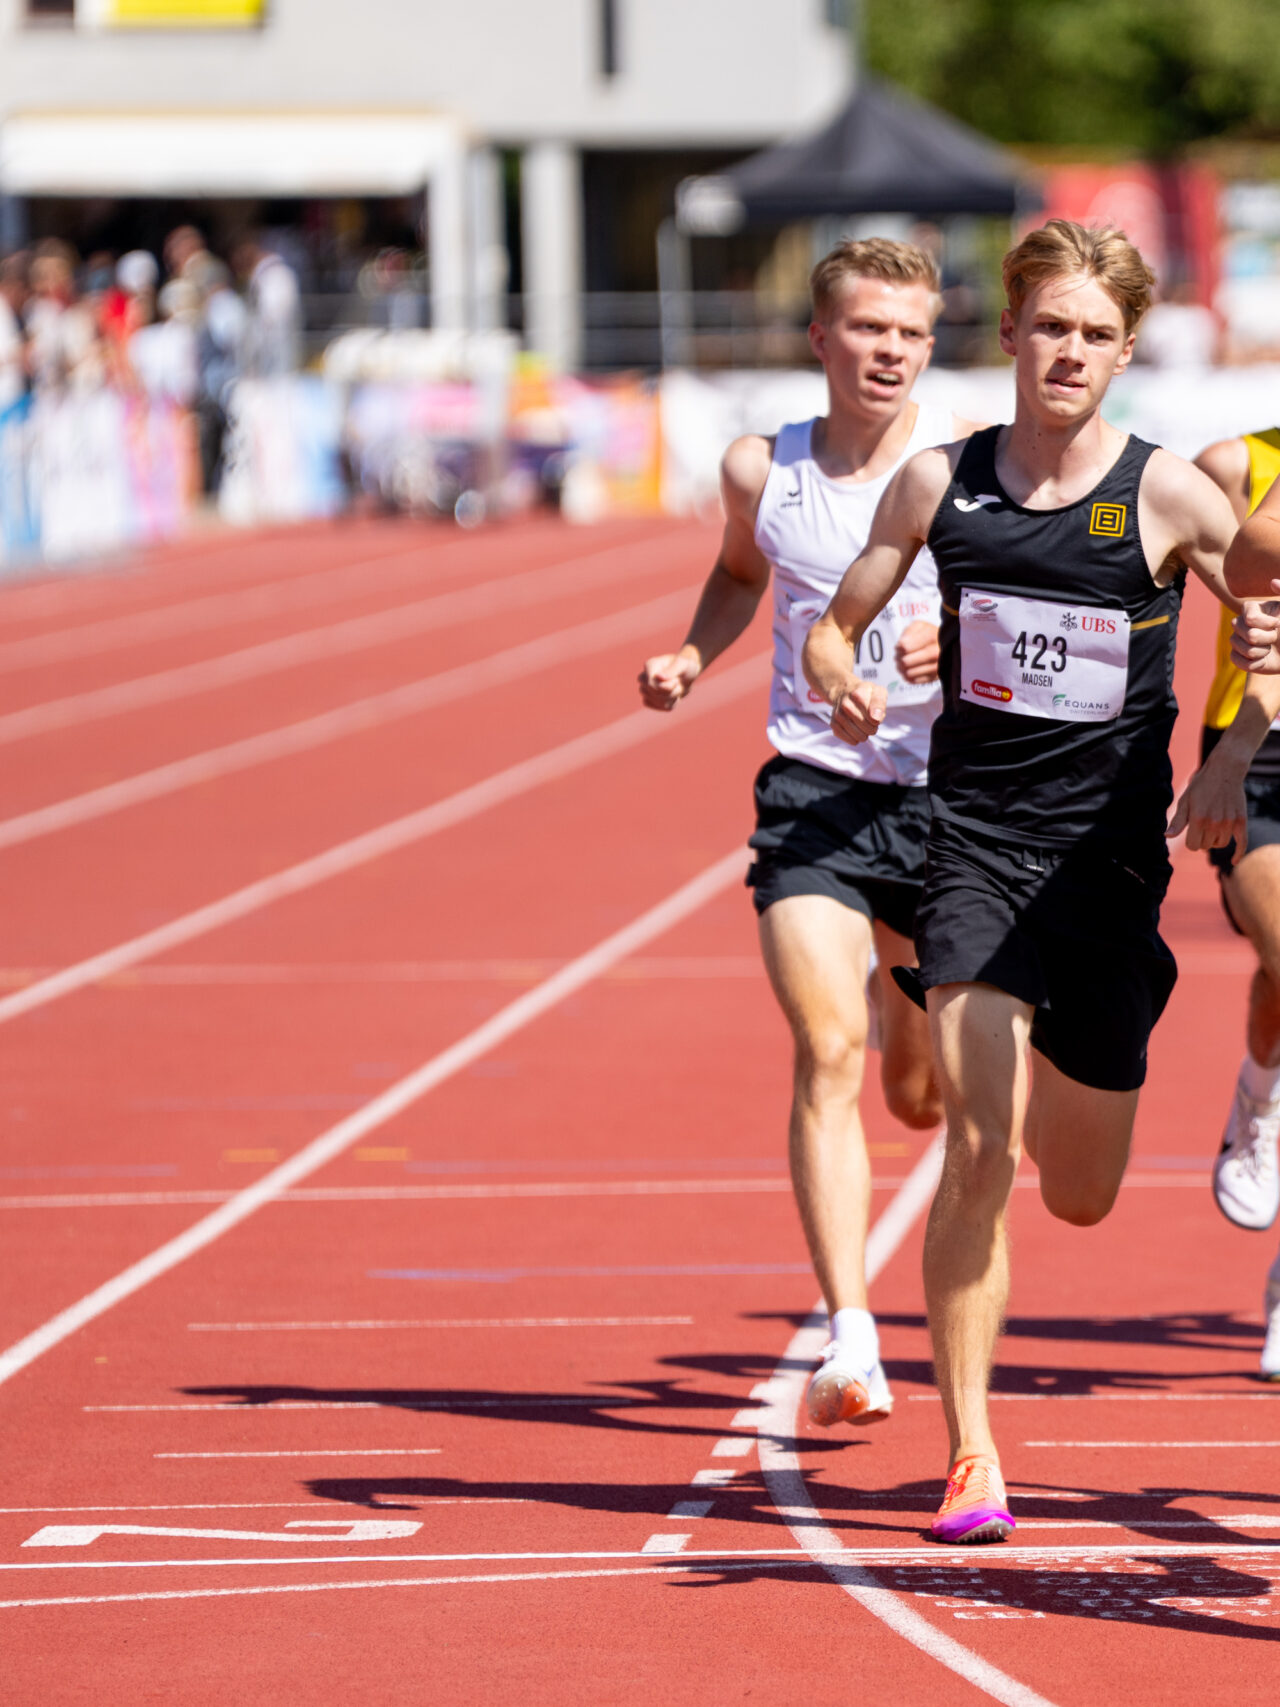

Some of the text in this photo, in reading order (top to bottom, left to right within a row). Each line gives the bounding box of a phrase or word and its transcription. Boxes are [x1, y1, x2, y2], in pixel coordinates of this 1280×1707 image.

[1081, 616, 1117, 634] UBS
[1011, 631, 1069, 673] 423
[1021, 672, 1054, 688] MADSEN
[973, 682, 1002, 698] familia
[1064, 699, 1110, 711] EQUANS
